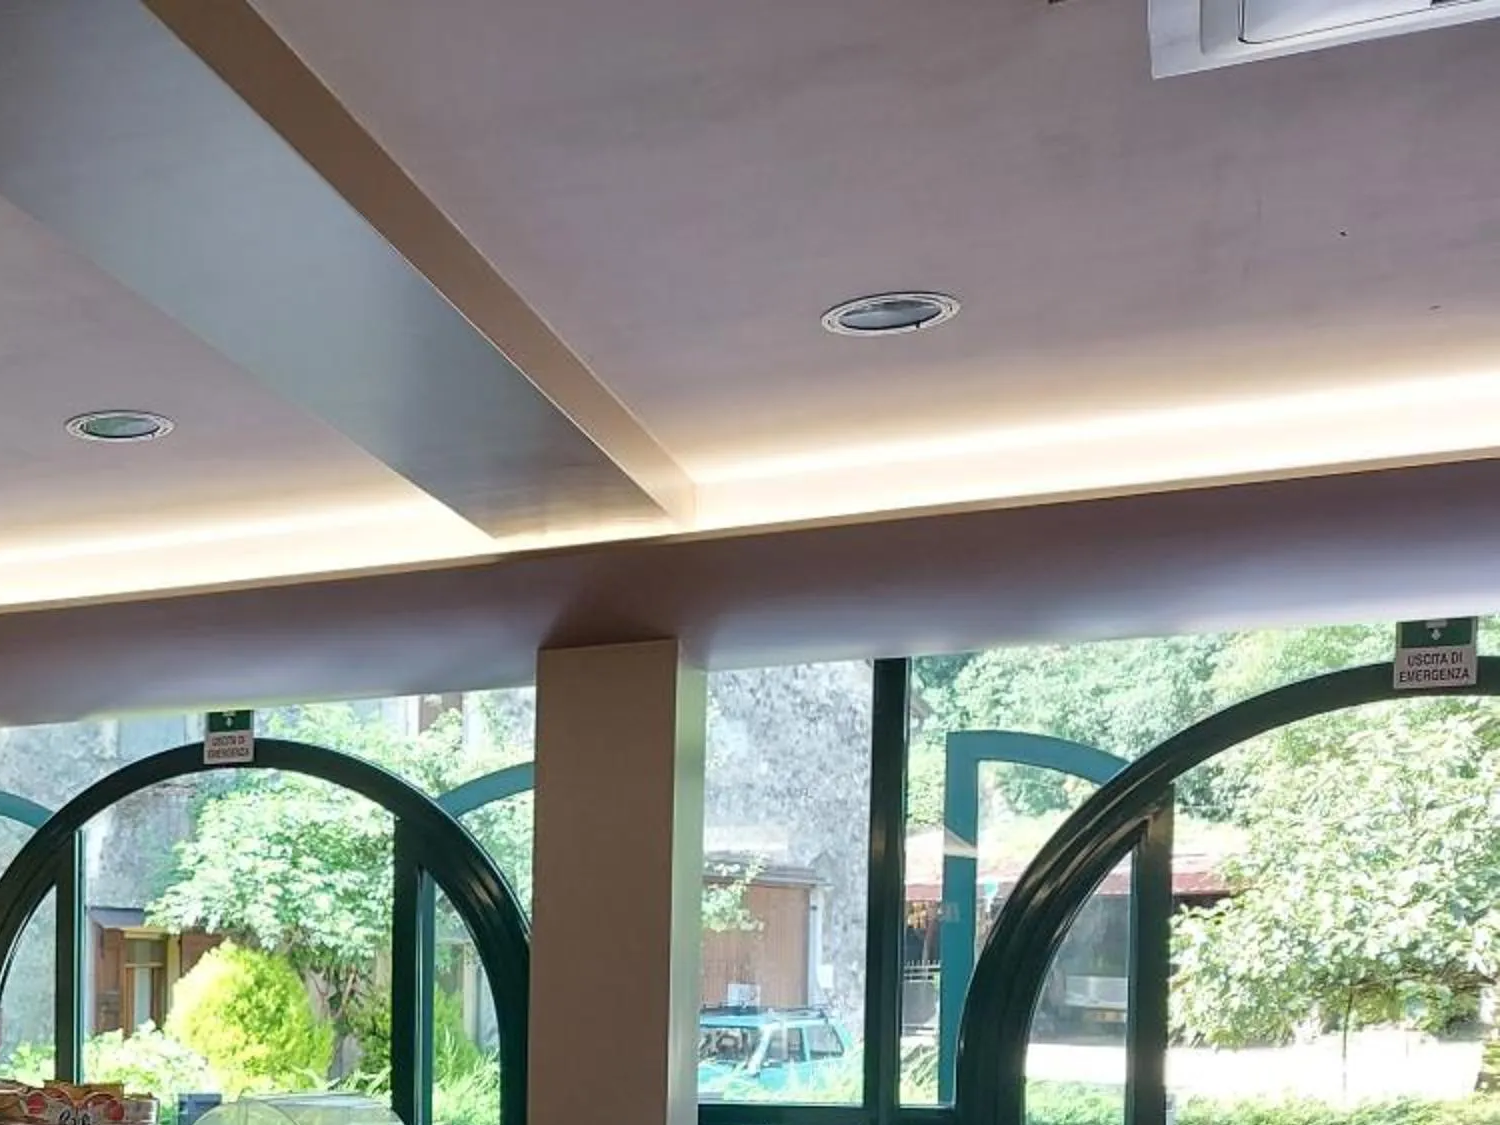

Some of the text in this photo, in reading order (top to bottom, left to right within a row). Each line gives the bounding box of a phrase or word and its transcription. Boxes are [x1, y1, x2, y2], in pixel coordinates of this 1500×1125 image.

[1408, 651, 1463, 666] USCITA DI
[1399, 667, 1469, 683] EMERGENZA
